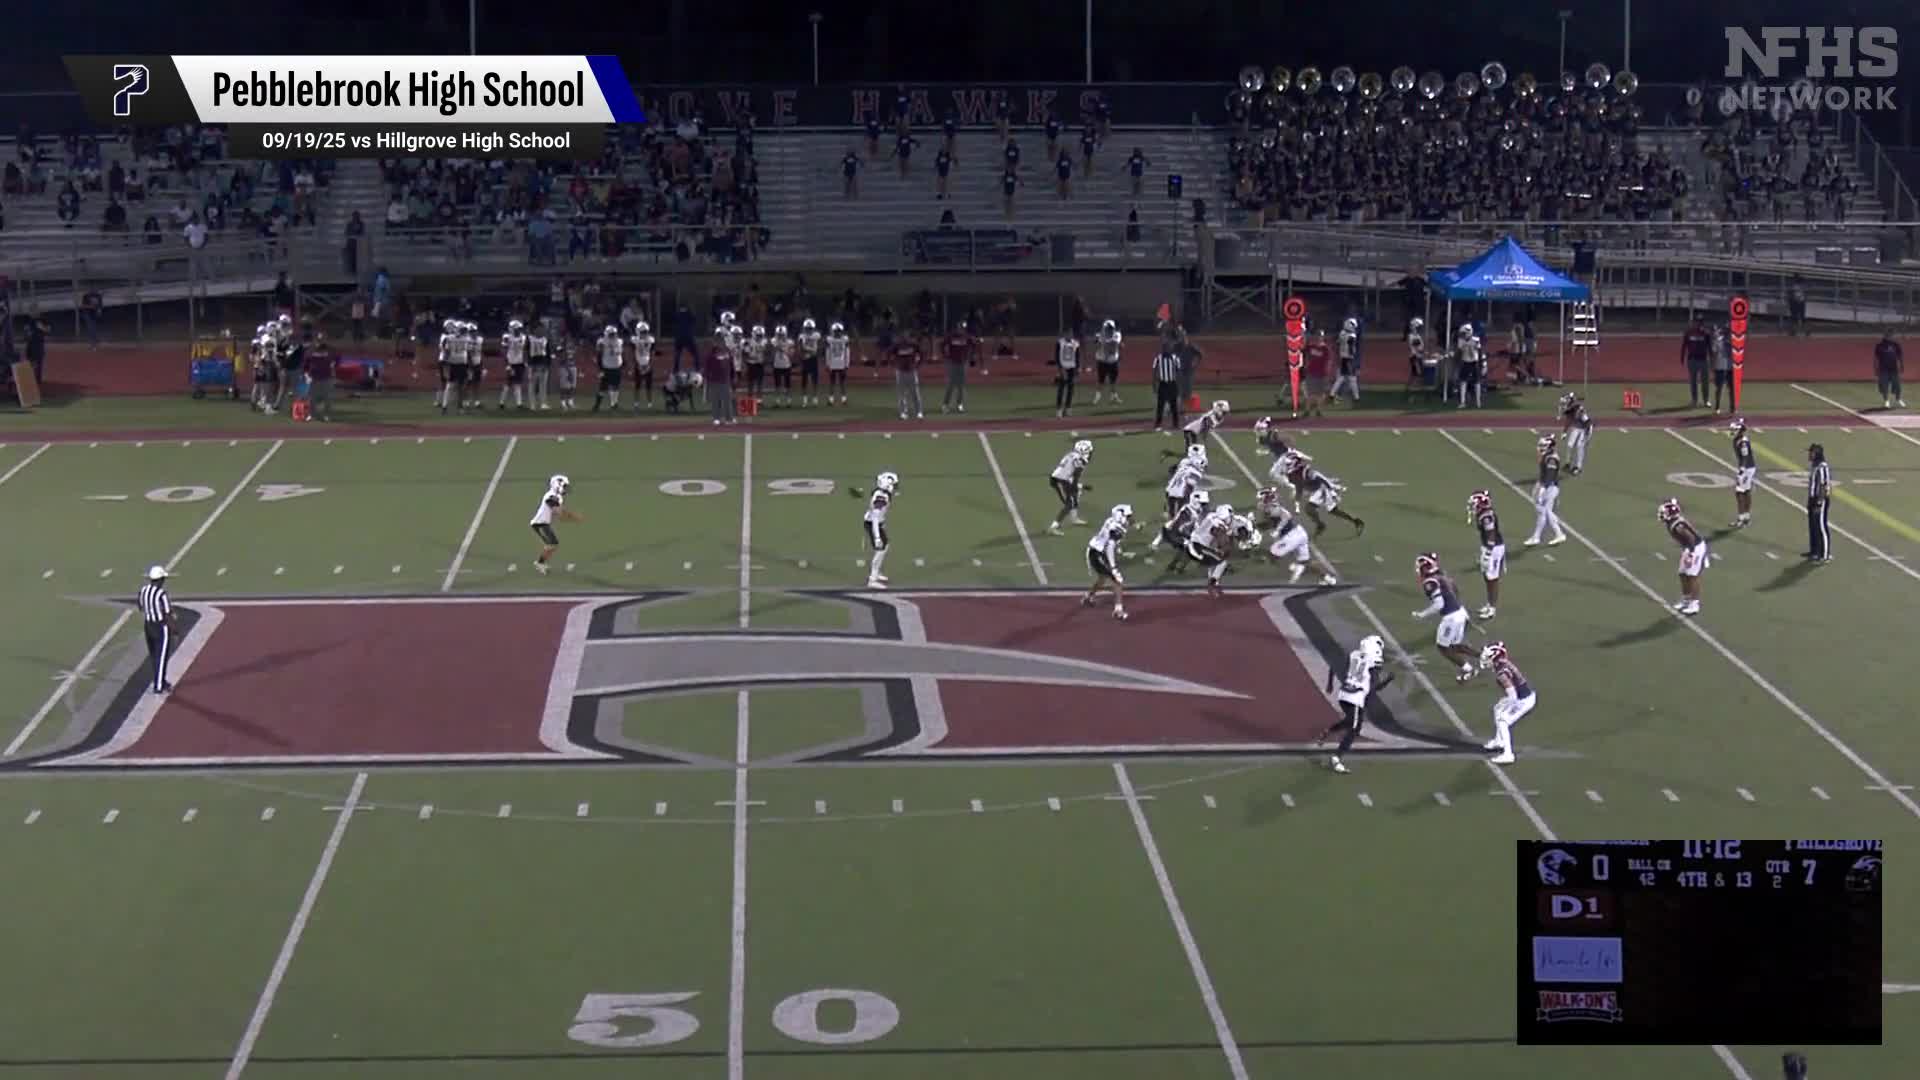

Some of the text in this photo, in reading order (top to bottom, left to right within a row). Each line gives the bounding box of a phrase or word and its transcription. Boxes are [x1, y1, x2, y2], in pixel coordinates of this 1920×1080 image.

[1591, 855, 1609, 881] 0
[1801, 859, 1818, 886] 7
[1676, 871, 1752, 889] 4TH & 13
[1772, 875, 1783, 889] 2
